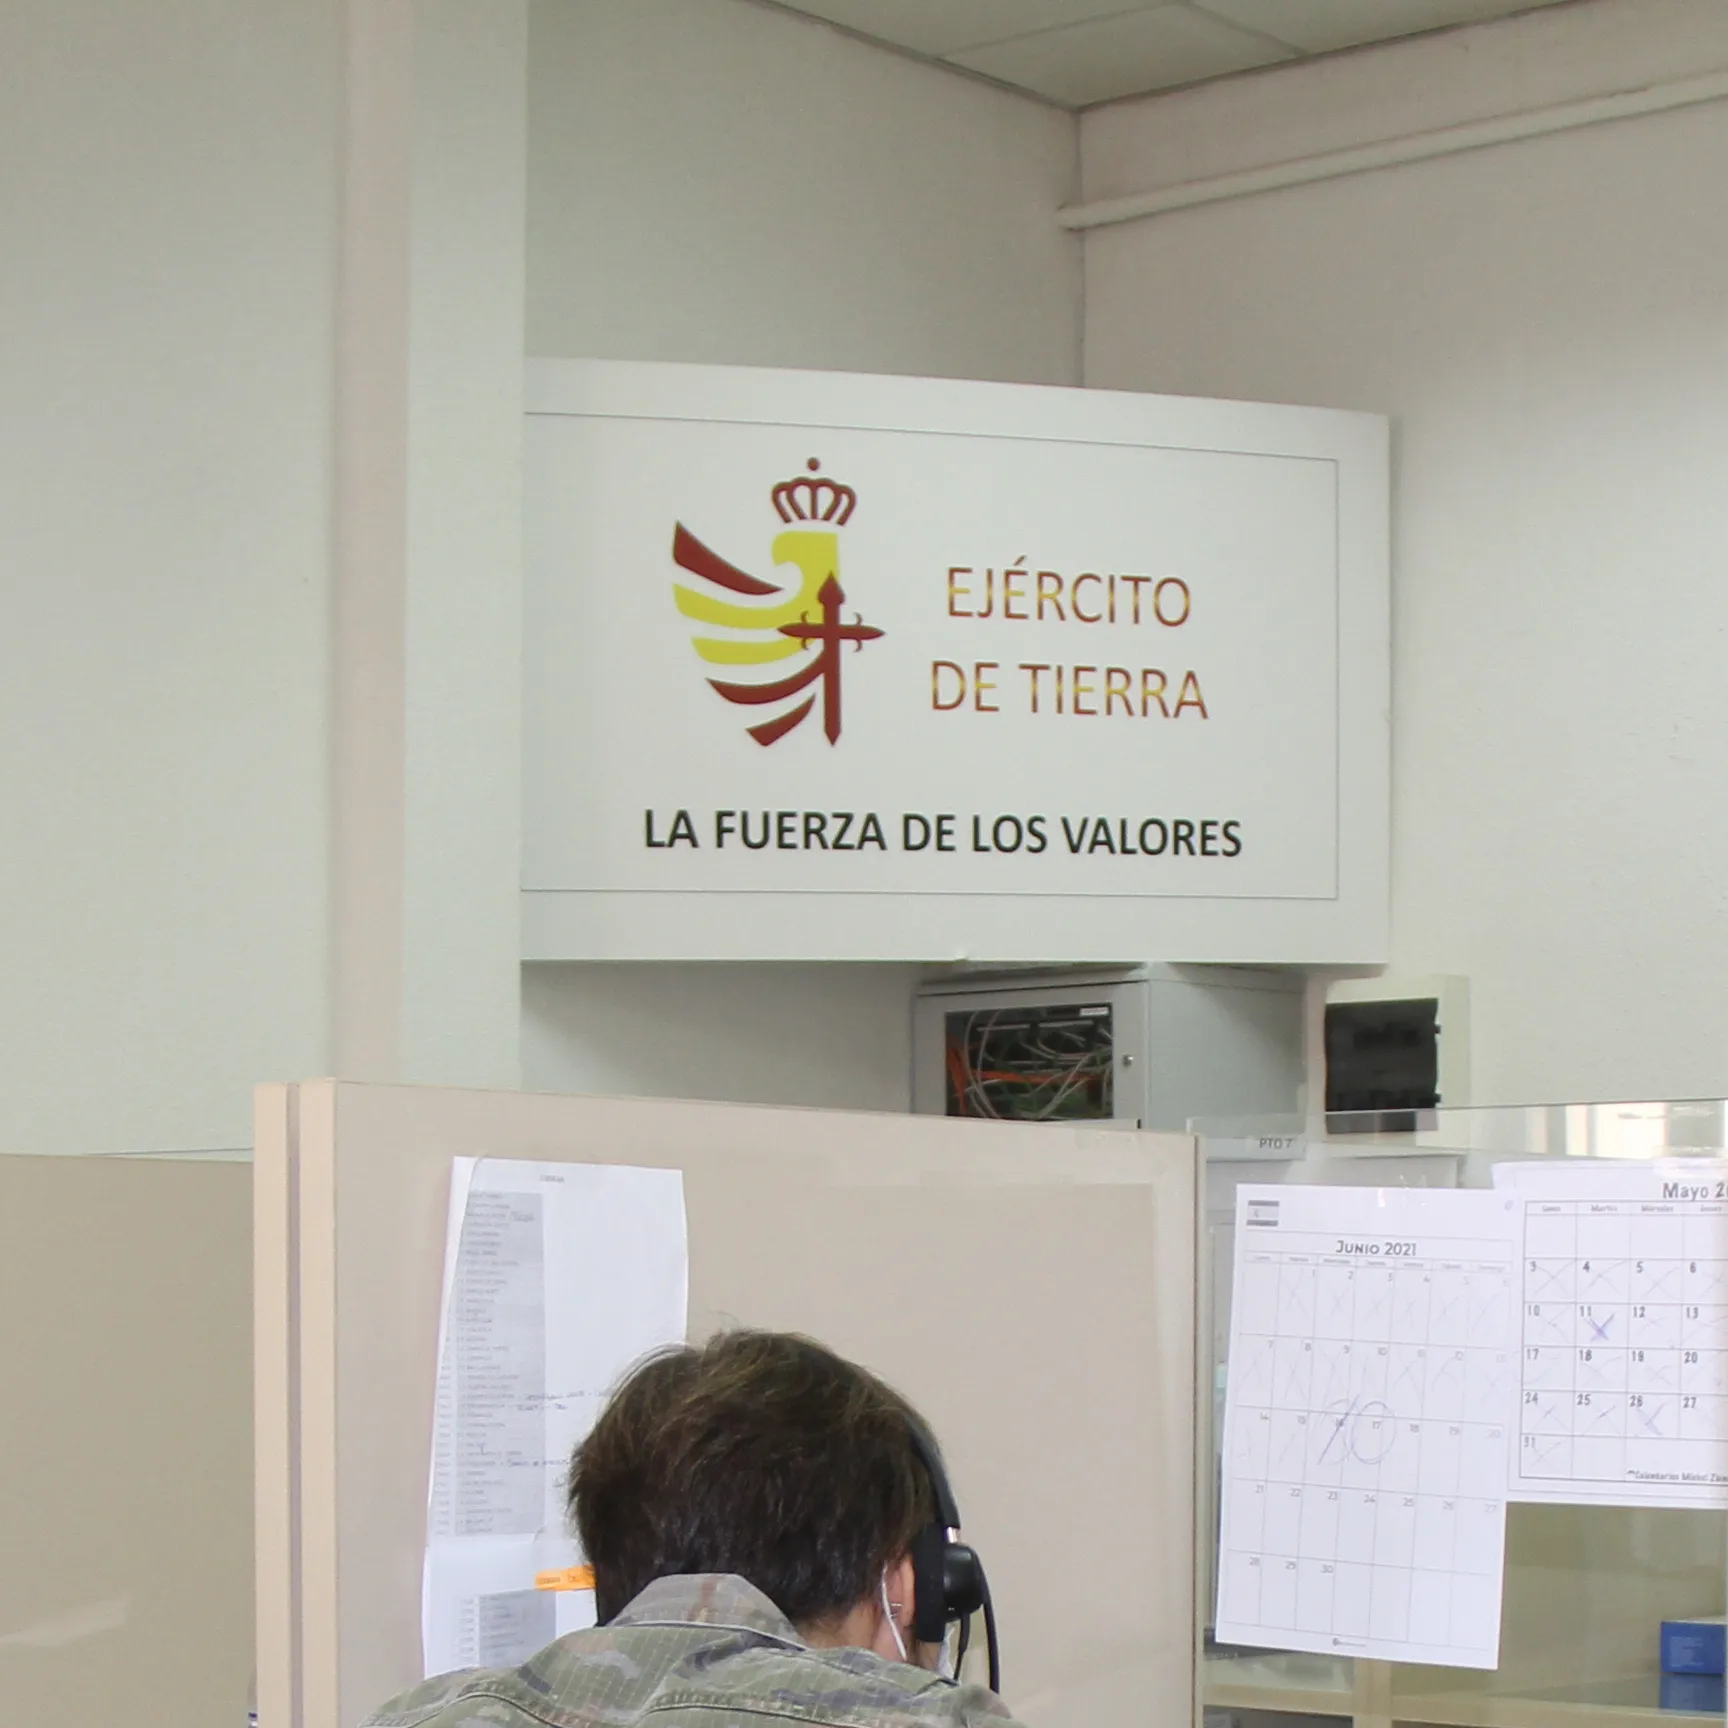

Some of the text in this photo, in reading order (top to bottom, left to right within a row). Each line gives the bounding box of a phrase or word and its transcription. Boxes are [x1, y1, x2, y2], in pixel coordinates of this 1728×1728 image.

[945, 555, 1192, 628] EJÉRCITO
[931, 660, 1209, 720] DE TIERRA
[644, 808, 1243, 858] LA FUERZA DE LOS VALORES
[1663, 1181, 1709, 1201] Mayo
[1384, 1242, 1417, 1257] 2021
[1527, 1305, 1699, 1319] 10 11 12 13
[1526, 1348, 1698, 1363] 17 18 19 20
[1525, 1392, 1697, 1408] 24 25 26 27
